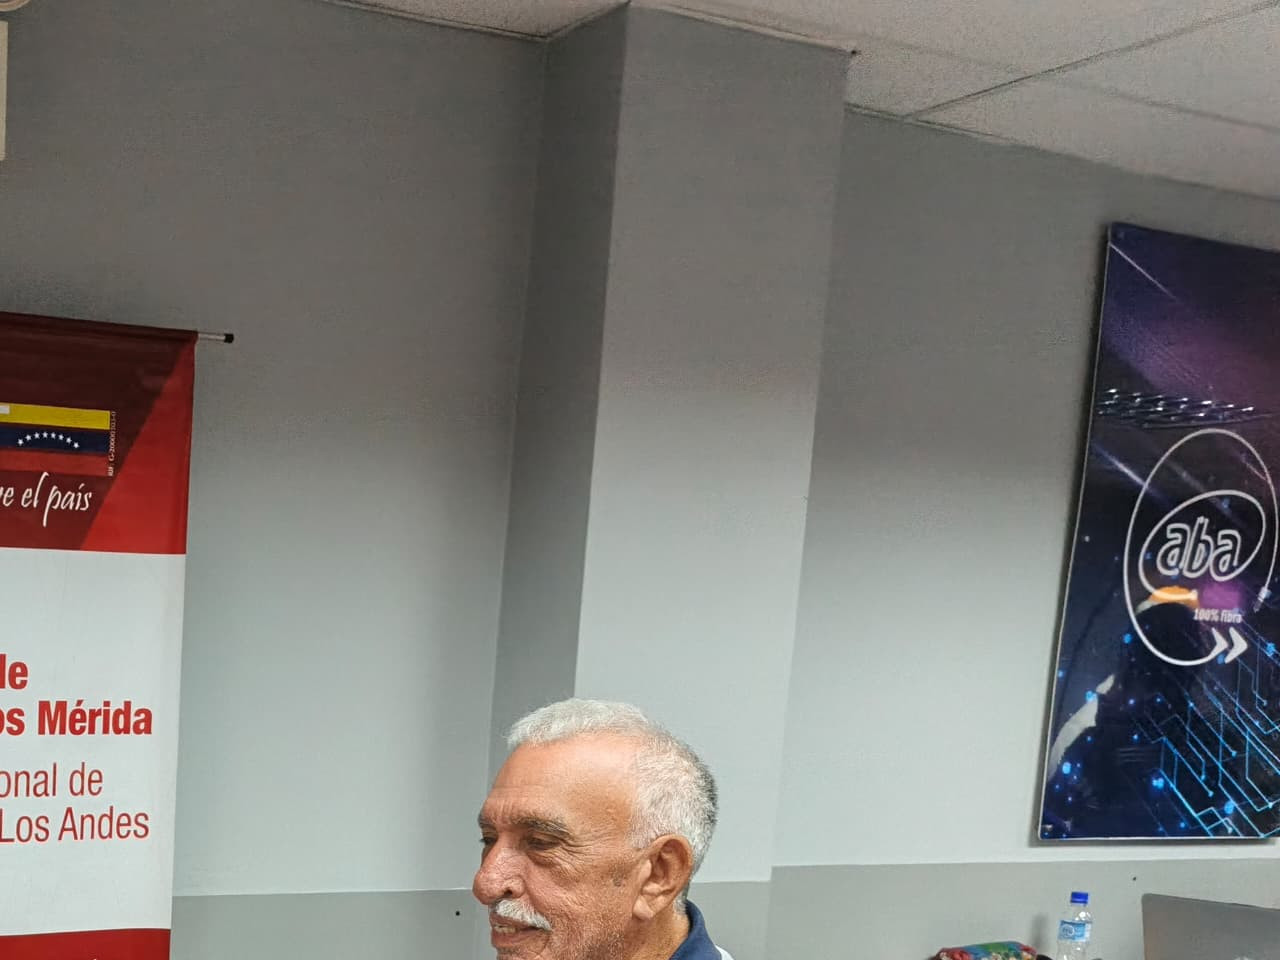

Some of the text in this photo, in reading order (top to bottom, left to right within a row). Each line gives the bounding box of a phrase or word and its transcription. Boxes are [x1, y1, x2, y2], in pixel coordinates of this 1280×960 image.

[21, 472, 49, 509] el
[43, 481, 94, 527] país
[1156, 515, 1241, 582] aba
[1194, 607, 1219, 621] 100%
[37, 700, 154, 736] Mérida
[68, 761, 104, 797] de
[58, 805, 151, 841] Andes
